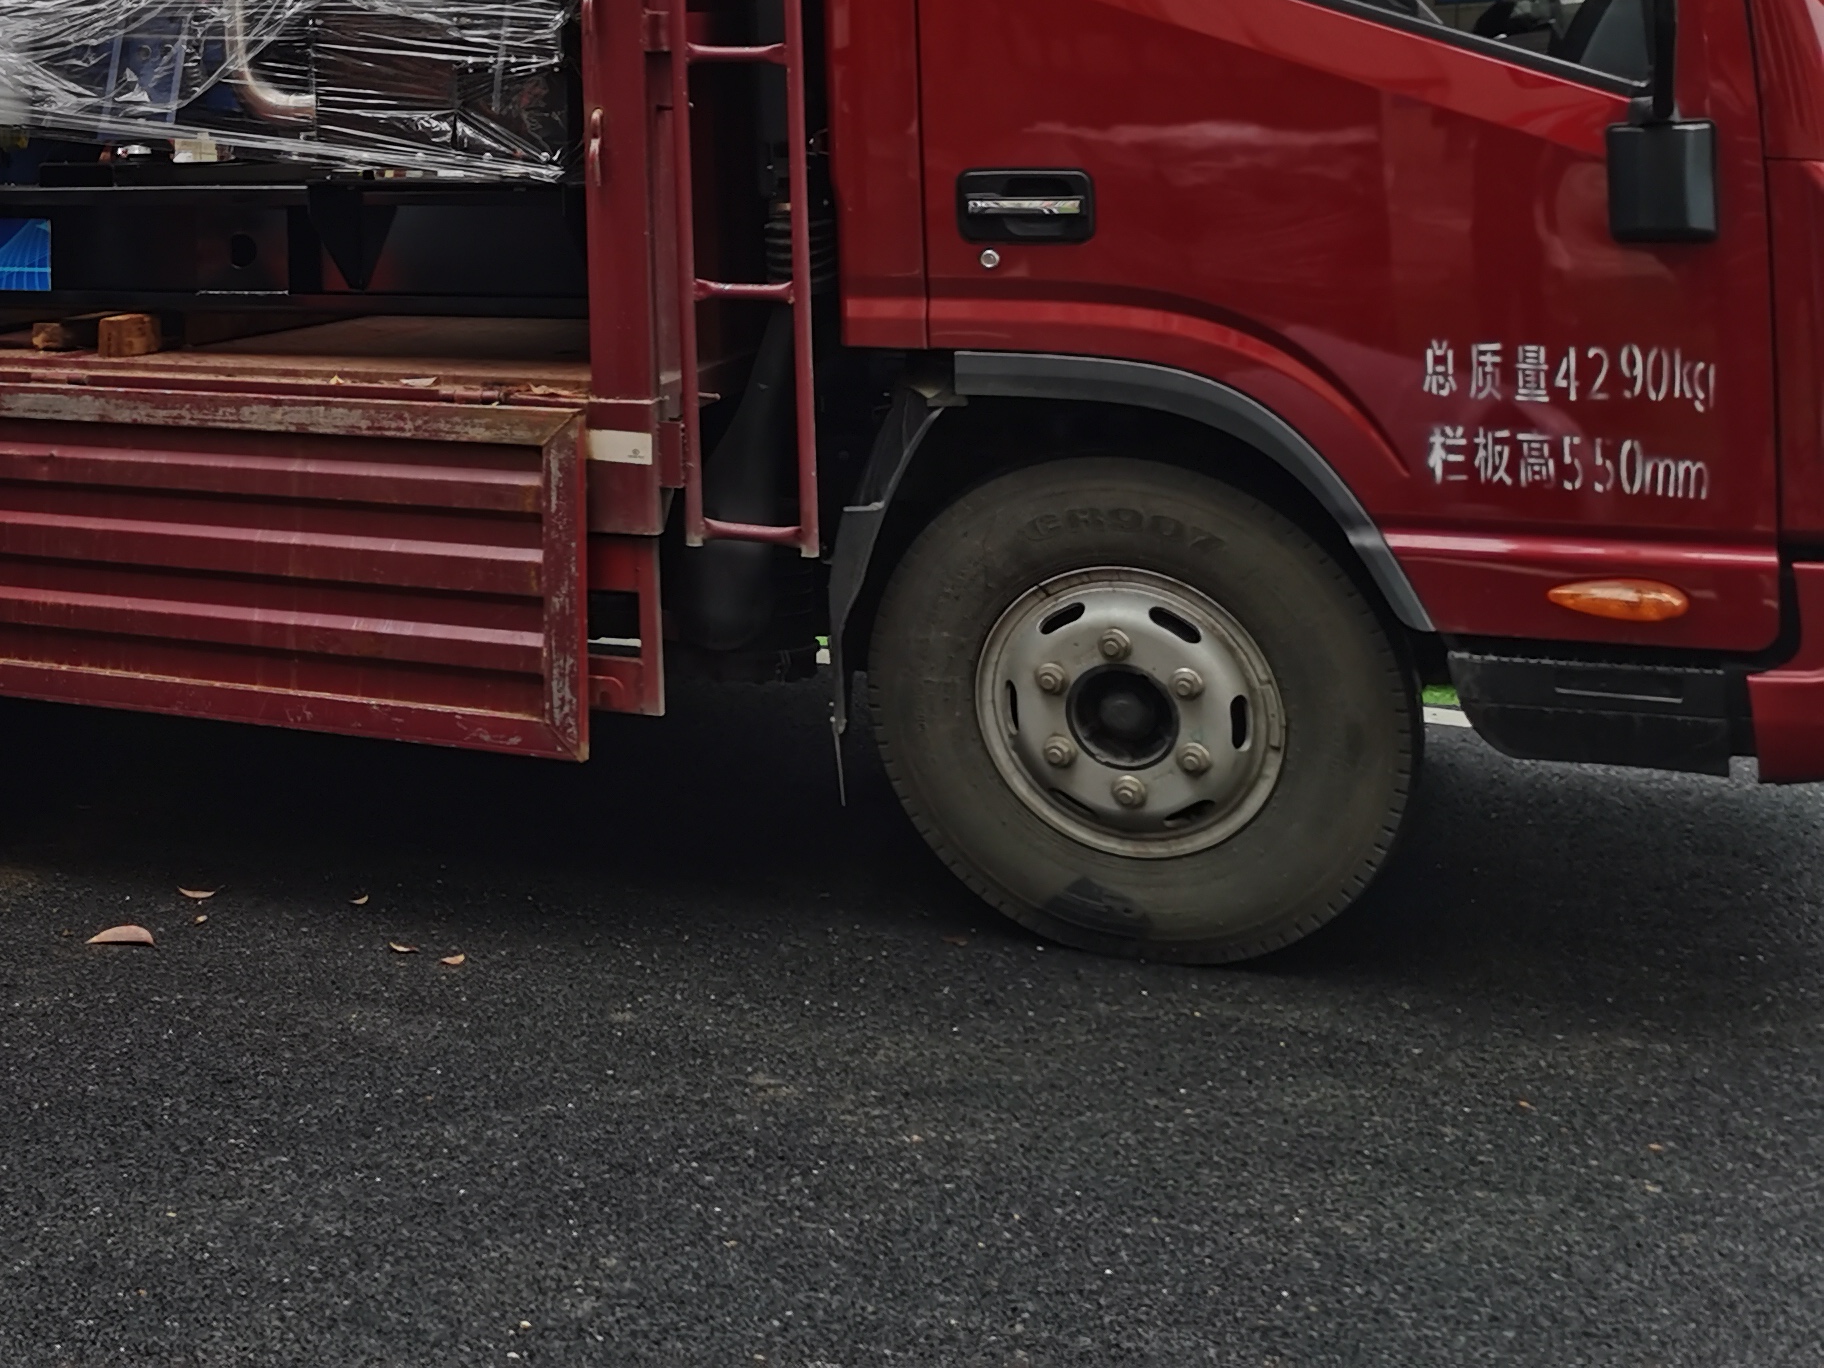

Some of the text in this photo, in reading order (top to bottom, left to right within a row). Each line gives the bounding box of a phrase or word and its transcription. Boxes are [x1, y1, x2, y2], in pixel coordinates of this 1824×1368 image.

[1422, 339, 1716, 413] 总质量4290kg
[1427, 425, 1710, 501] 栏板高550mm
